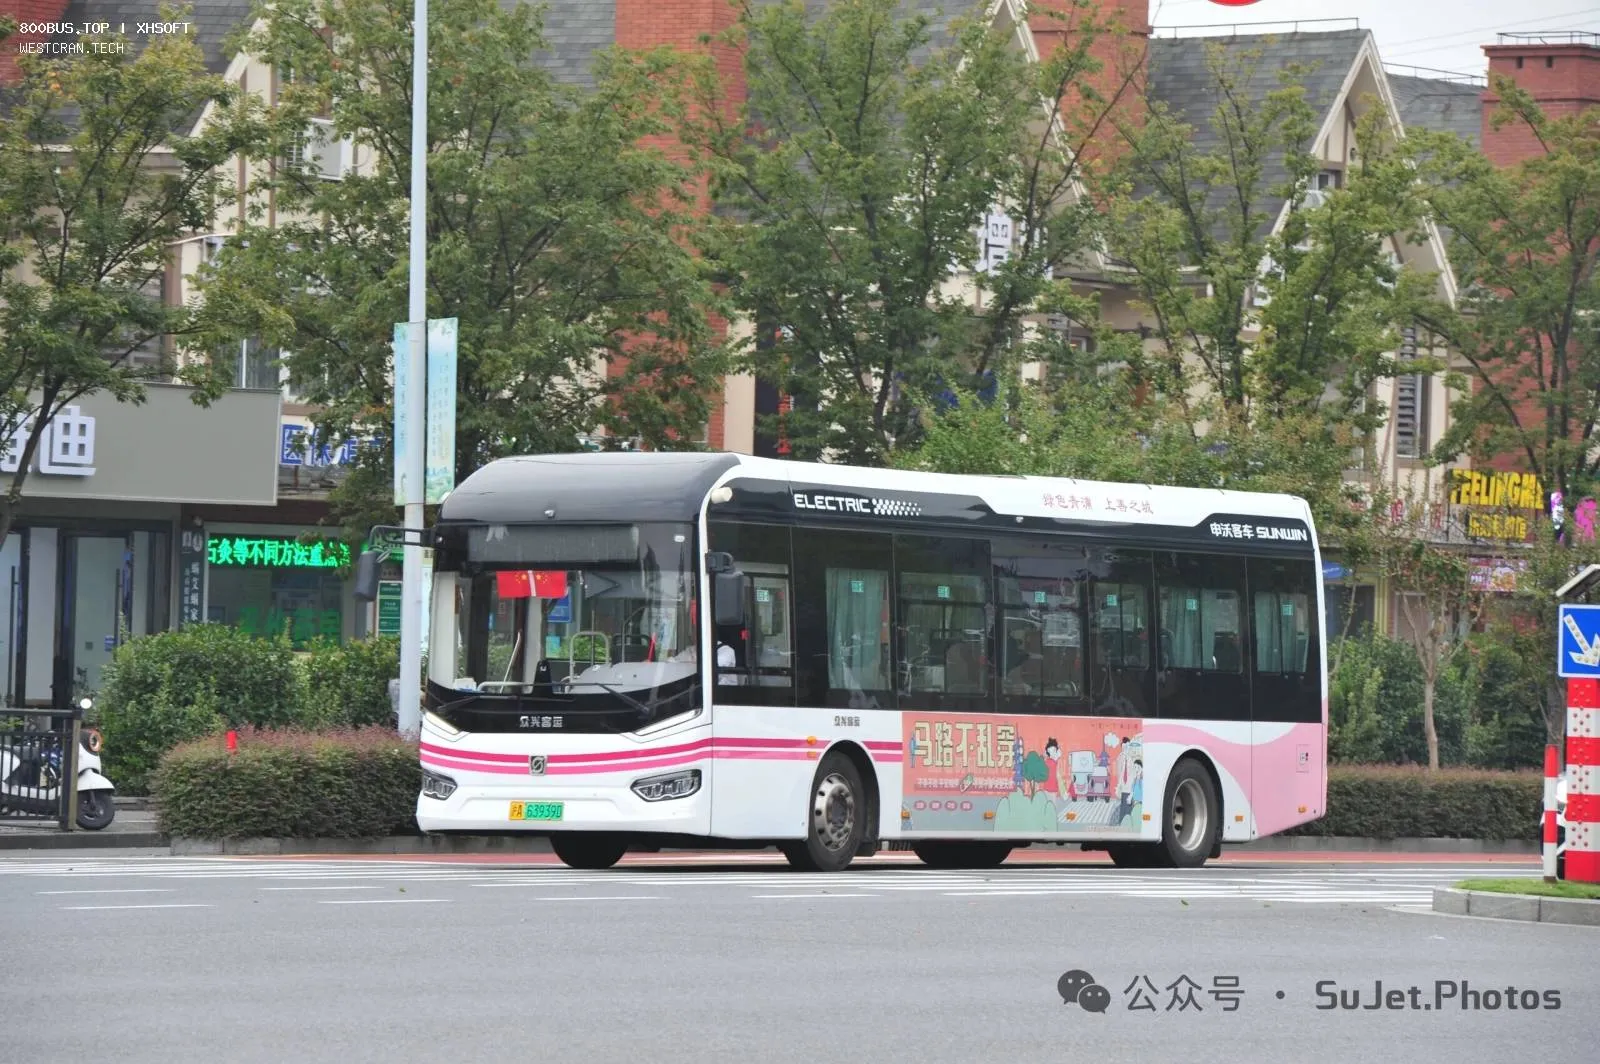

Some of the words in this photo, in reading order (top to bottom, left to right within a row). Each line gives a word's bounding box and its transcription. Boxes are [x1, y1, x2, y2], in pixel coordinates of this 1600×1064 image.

[793, 493, 871, 513] ELECTRIC
[1105, 497, 1154, 515] 上善之城
[1209, 522, 1255, 539] 申沃客车
[1256, 526, 1308, 541] SUNWIN
[519, 715, 564, 728] 众兴客运
[913, 721, 1016, 768] 马路不乱穿
